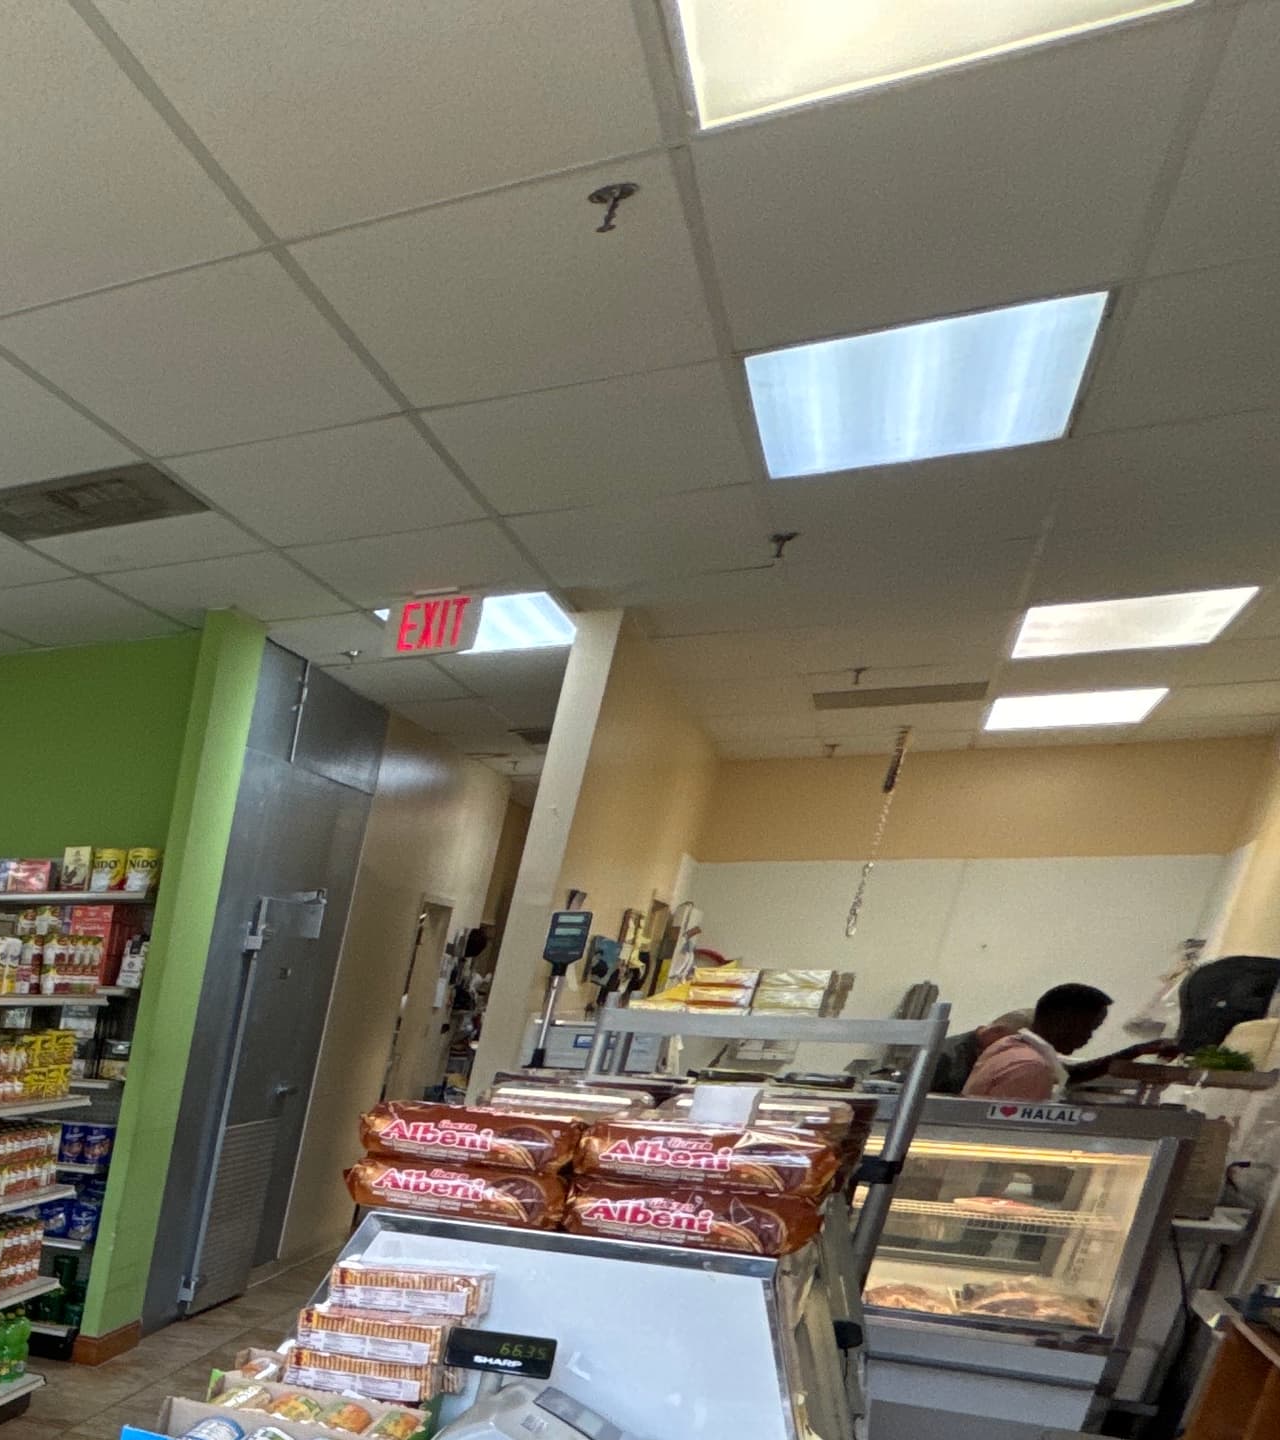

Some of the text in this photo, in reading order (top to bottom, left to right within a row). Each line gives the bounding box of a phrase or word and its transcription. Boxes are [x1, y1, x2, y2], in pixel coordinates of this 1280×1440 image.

[396, 596, 471, 652] EXIT
[989, 1105, 1076, 1122] I HALAL
[381, 1118, 494, 1152] Albeni
[599, 1139, 734, 1173] Albeni
[373, 1167, 486, 1202] Albeni
[582, 1197, 715, 1234] Albeni
[473, 1355, 523, 1368] SHARP
